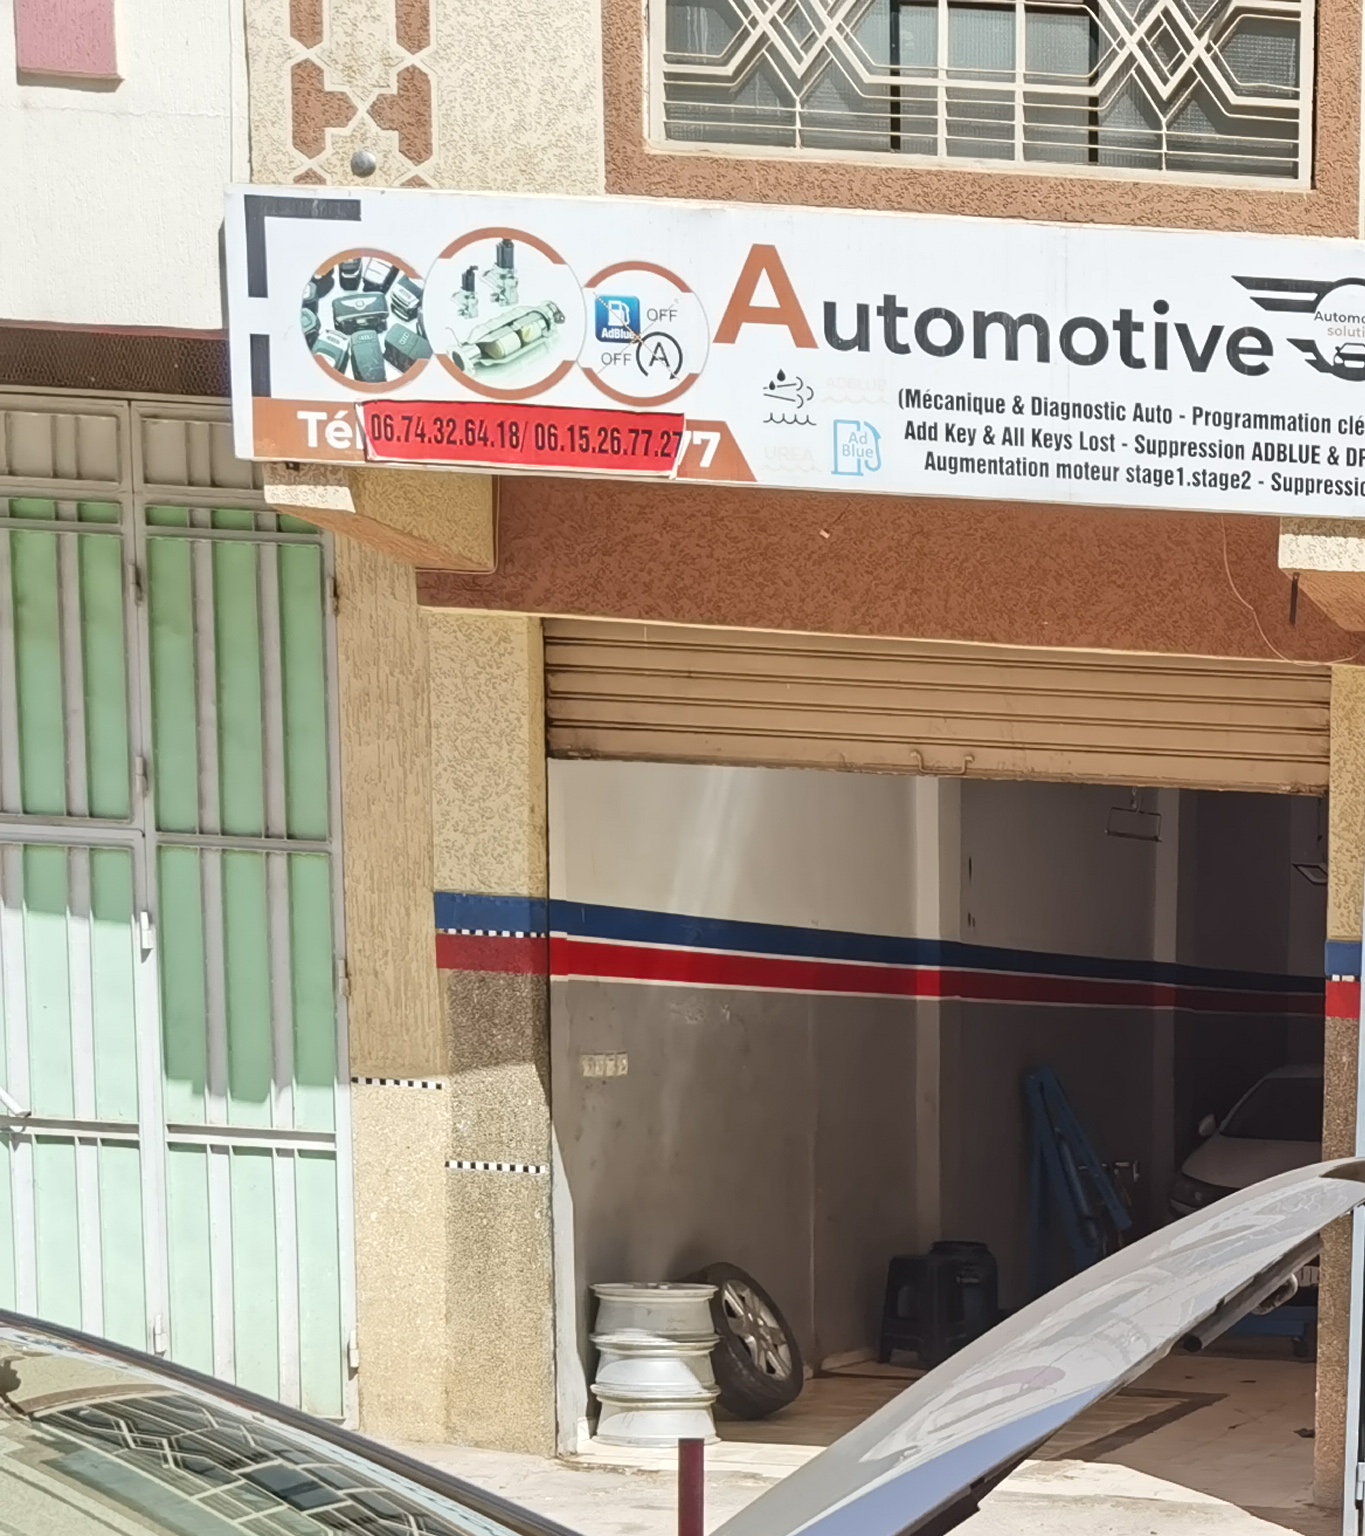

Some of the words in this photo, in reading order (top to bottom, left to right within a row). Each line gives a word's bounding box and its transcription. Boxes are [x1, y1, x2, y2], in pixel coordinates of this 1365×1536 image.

[646, 308, 678, 322] OFF
[712, 242, 1274, 377] Automotive
[600, 352, 632, 366] OFF
[899, 388, 1006, 415] (Mécanique
[1012, 395, 1025, 415] &
[1031, 396, 1126, 421] Diagnostic
[1132, 402, 1173, 425] Auto
[1192, 405, 1332, 434] Programmation
[1338, 415, 1365, 436] clé
[534, 422, 683, 459] 06.15.26.77.27
[842, 444, 874, 459] Blue
[848, 431, 868, 445] Ad
[904, 420, 938, 442] Add
[944, 422, 977, 446] Key
[983, 425, 995, 445] &
[1001, 426, 1025, 447] All
[1031, 428, 1073, 451] Keys
[1079, 430, 1116, 452] Lost
[1134, 433, 1245, 460] Suppression
[1251, 441, 1321, 465] ADBLUE
[1327, 446, 1340, 466] &
[924, 451, 1050, 478] Augmentation
[1056, 461, 1120, 483] moteur
[1126, 464, 1252, 491] stage1.stage2
